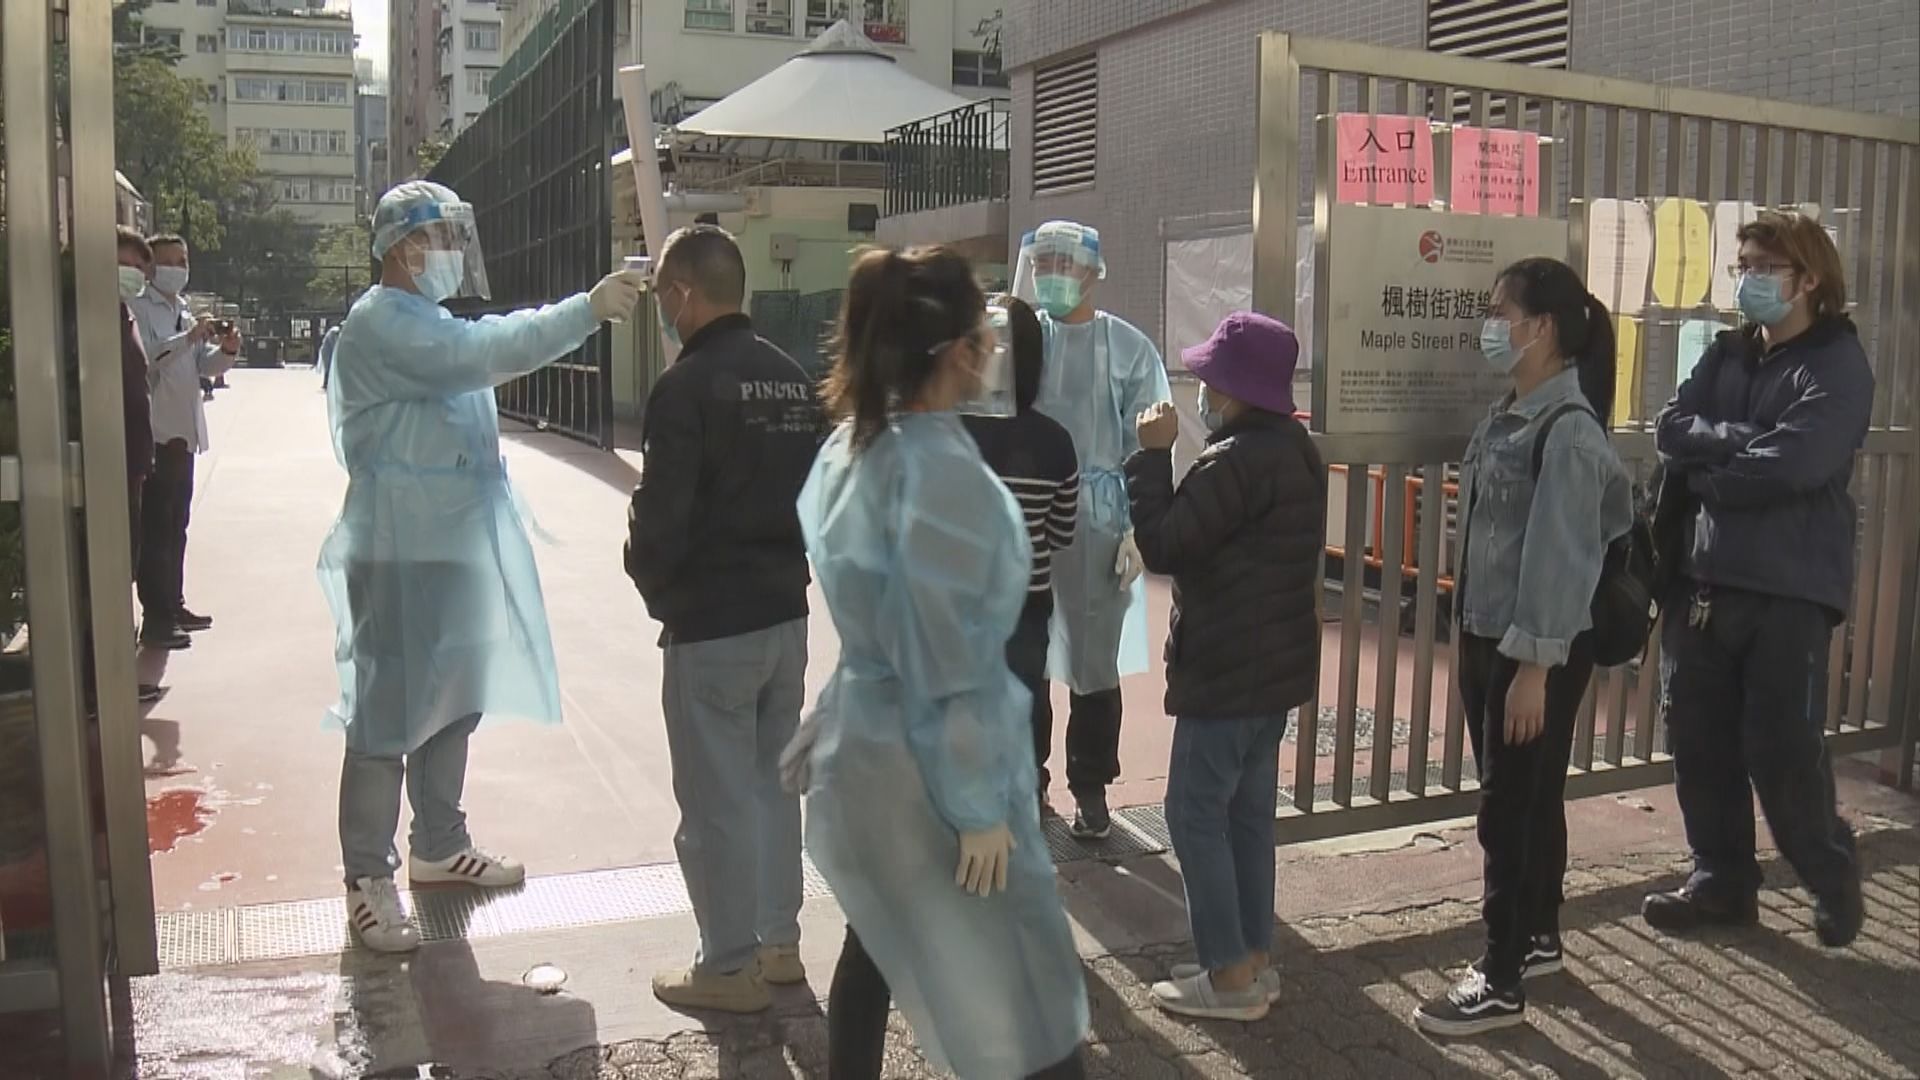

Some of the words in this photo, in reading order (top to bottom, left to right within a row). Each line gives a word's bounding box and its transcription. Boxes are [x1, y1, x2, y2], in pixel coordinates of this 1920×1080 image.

[1358, 128, 1414, 152] 入口
[1344, 160, 1426, 183] Entrance
[1361, 330, 1405, 352] Maple
[1411, 332, 1453, 349] Street
